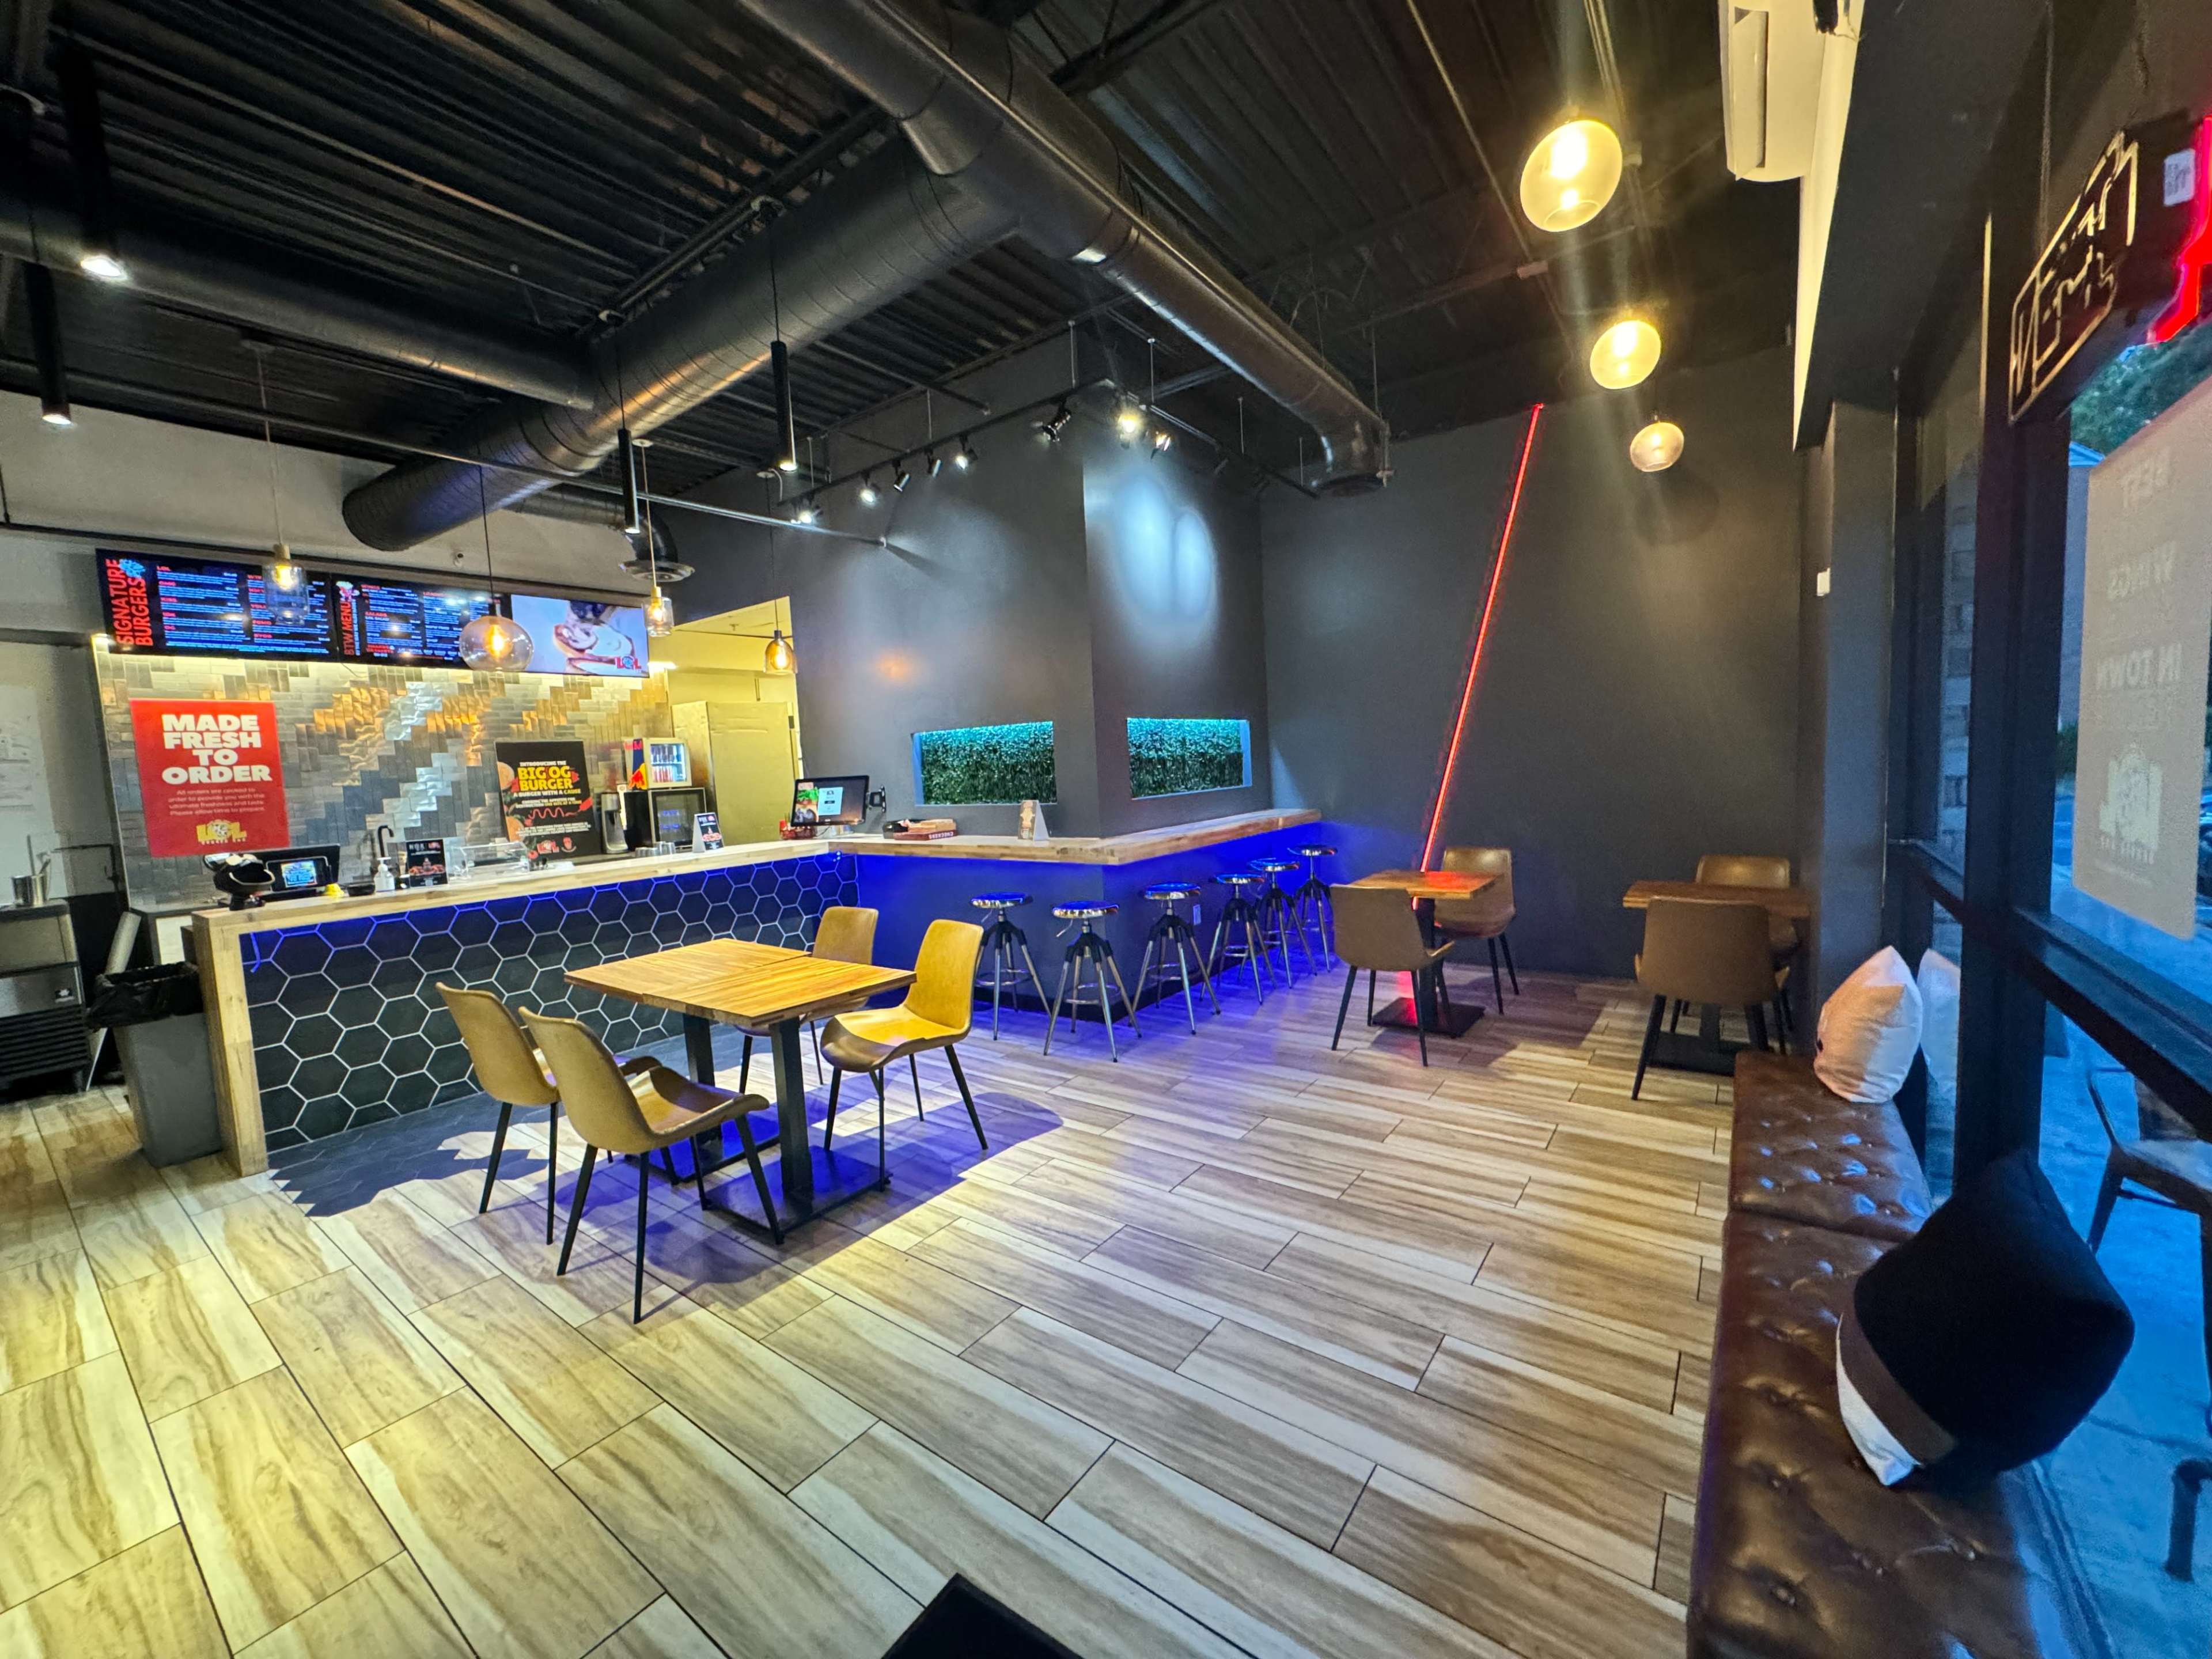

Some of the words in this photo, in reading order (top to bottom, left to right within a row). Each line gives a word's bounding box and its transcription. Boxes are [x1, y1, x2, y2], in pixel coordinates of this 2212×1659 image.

[105, 558, 135, 645] SIGNATURE
[127, 577, 154, 646] BURGERS
[340, 601, 353, 631] MENU
[161, 714, 260, 732] MADE
[162, 731, 262, 749] FRESH
[192, 749, 238, 766] TO
[161, 765, 272, 785] ORDER
[517, 767, 547, 780] BIG
[548, 766, 571, 778] OG
[520, 779, 573, 791] BURGER
